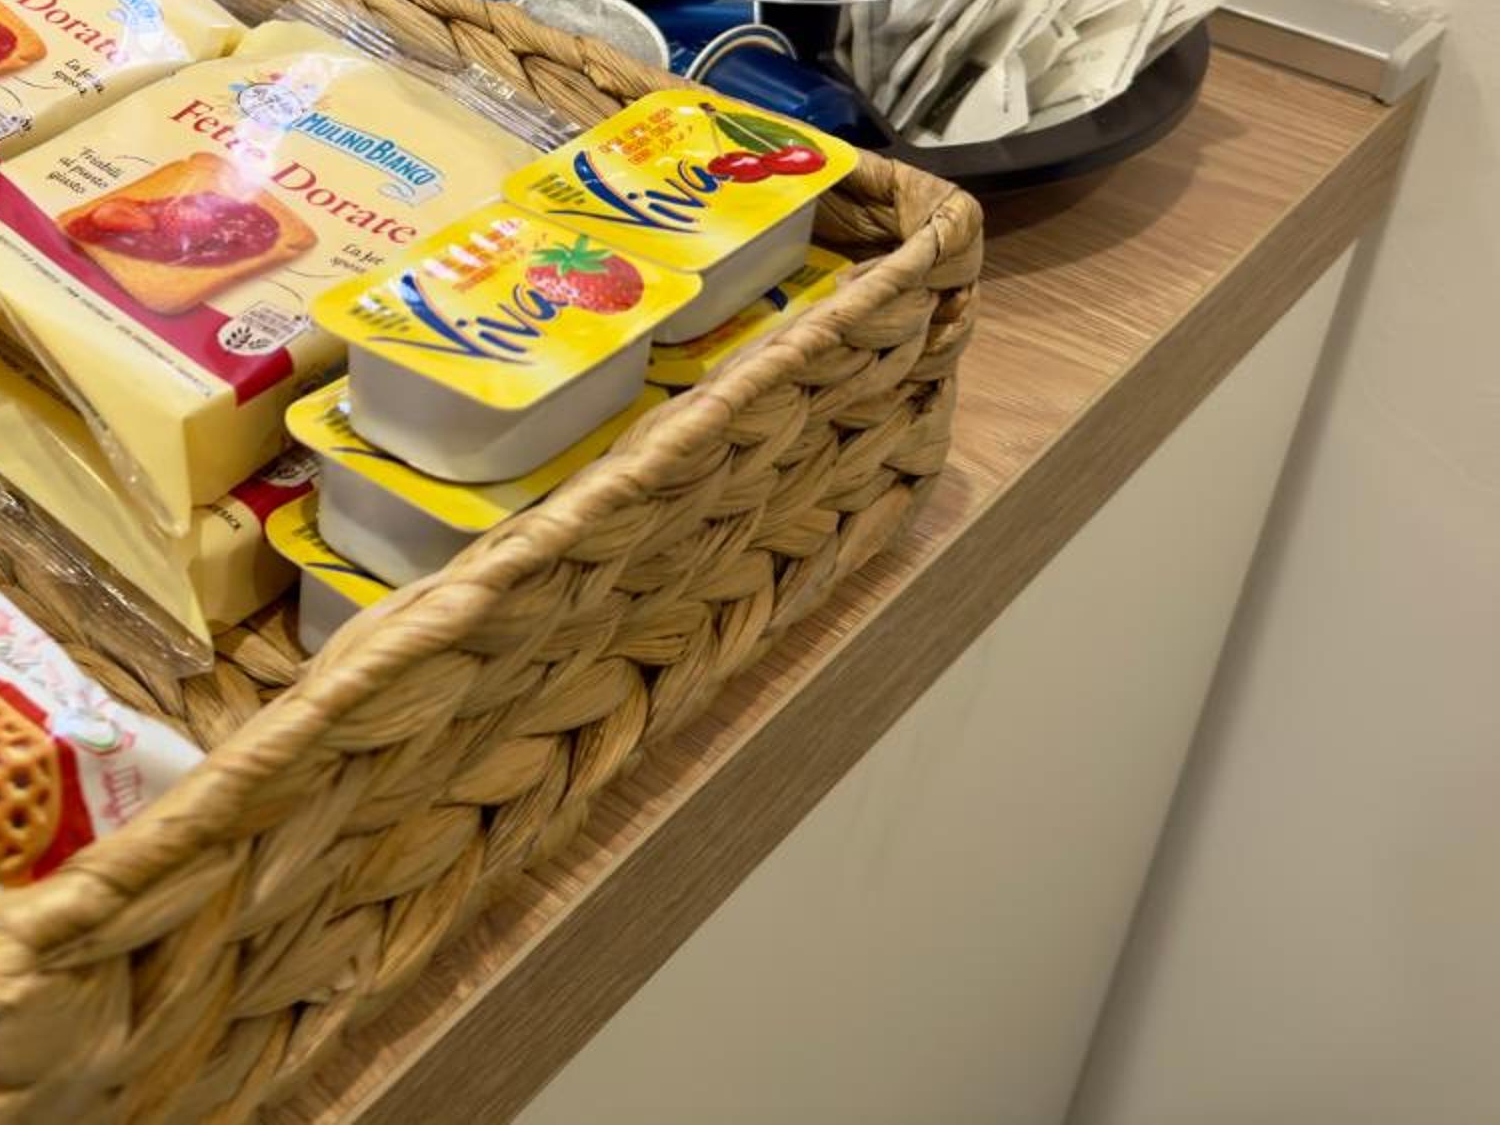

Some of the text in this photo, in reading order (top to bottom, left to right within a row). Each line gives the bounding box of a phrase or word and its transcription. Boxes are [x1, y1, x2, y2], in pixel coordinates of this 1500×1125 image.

[271, 158, 419, 247] Dorate
[549, 151, 736, 234] Viva
[368, 273, 579, 366] Viva
